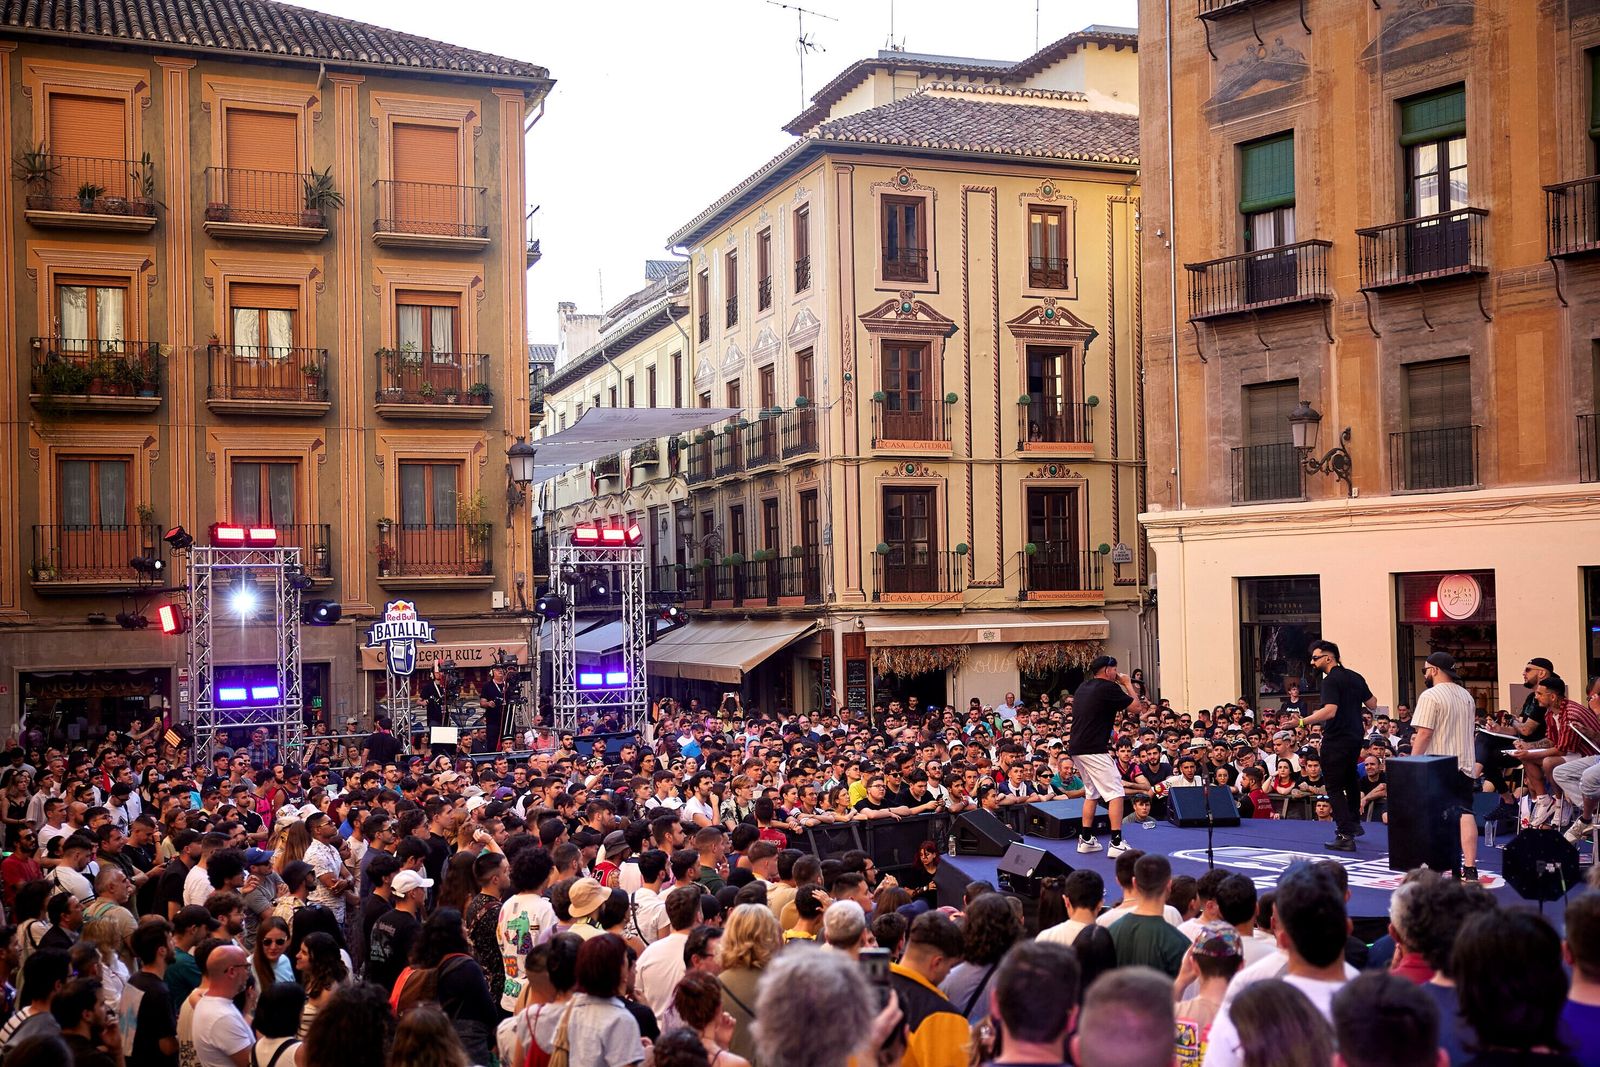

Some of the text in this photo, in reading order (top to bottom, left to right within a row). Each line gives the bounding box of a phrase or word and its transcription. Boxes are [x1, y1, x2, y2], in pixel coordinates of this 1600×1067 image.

[884, 441, 950, 449] CASA CATEDRAL
[890, 593, 960, 602] CASA CATEDRAL
[386, 612, 416, 621] Red Bull
[376, 622, 427, 640] BATALLA
[455, 649, 483, 661] RUIZ
